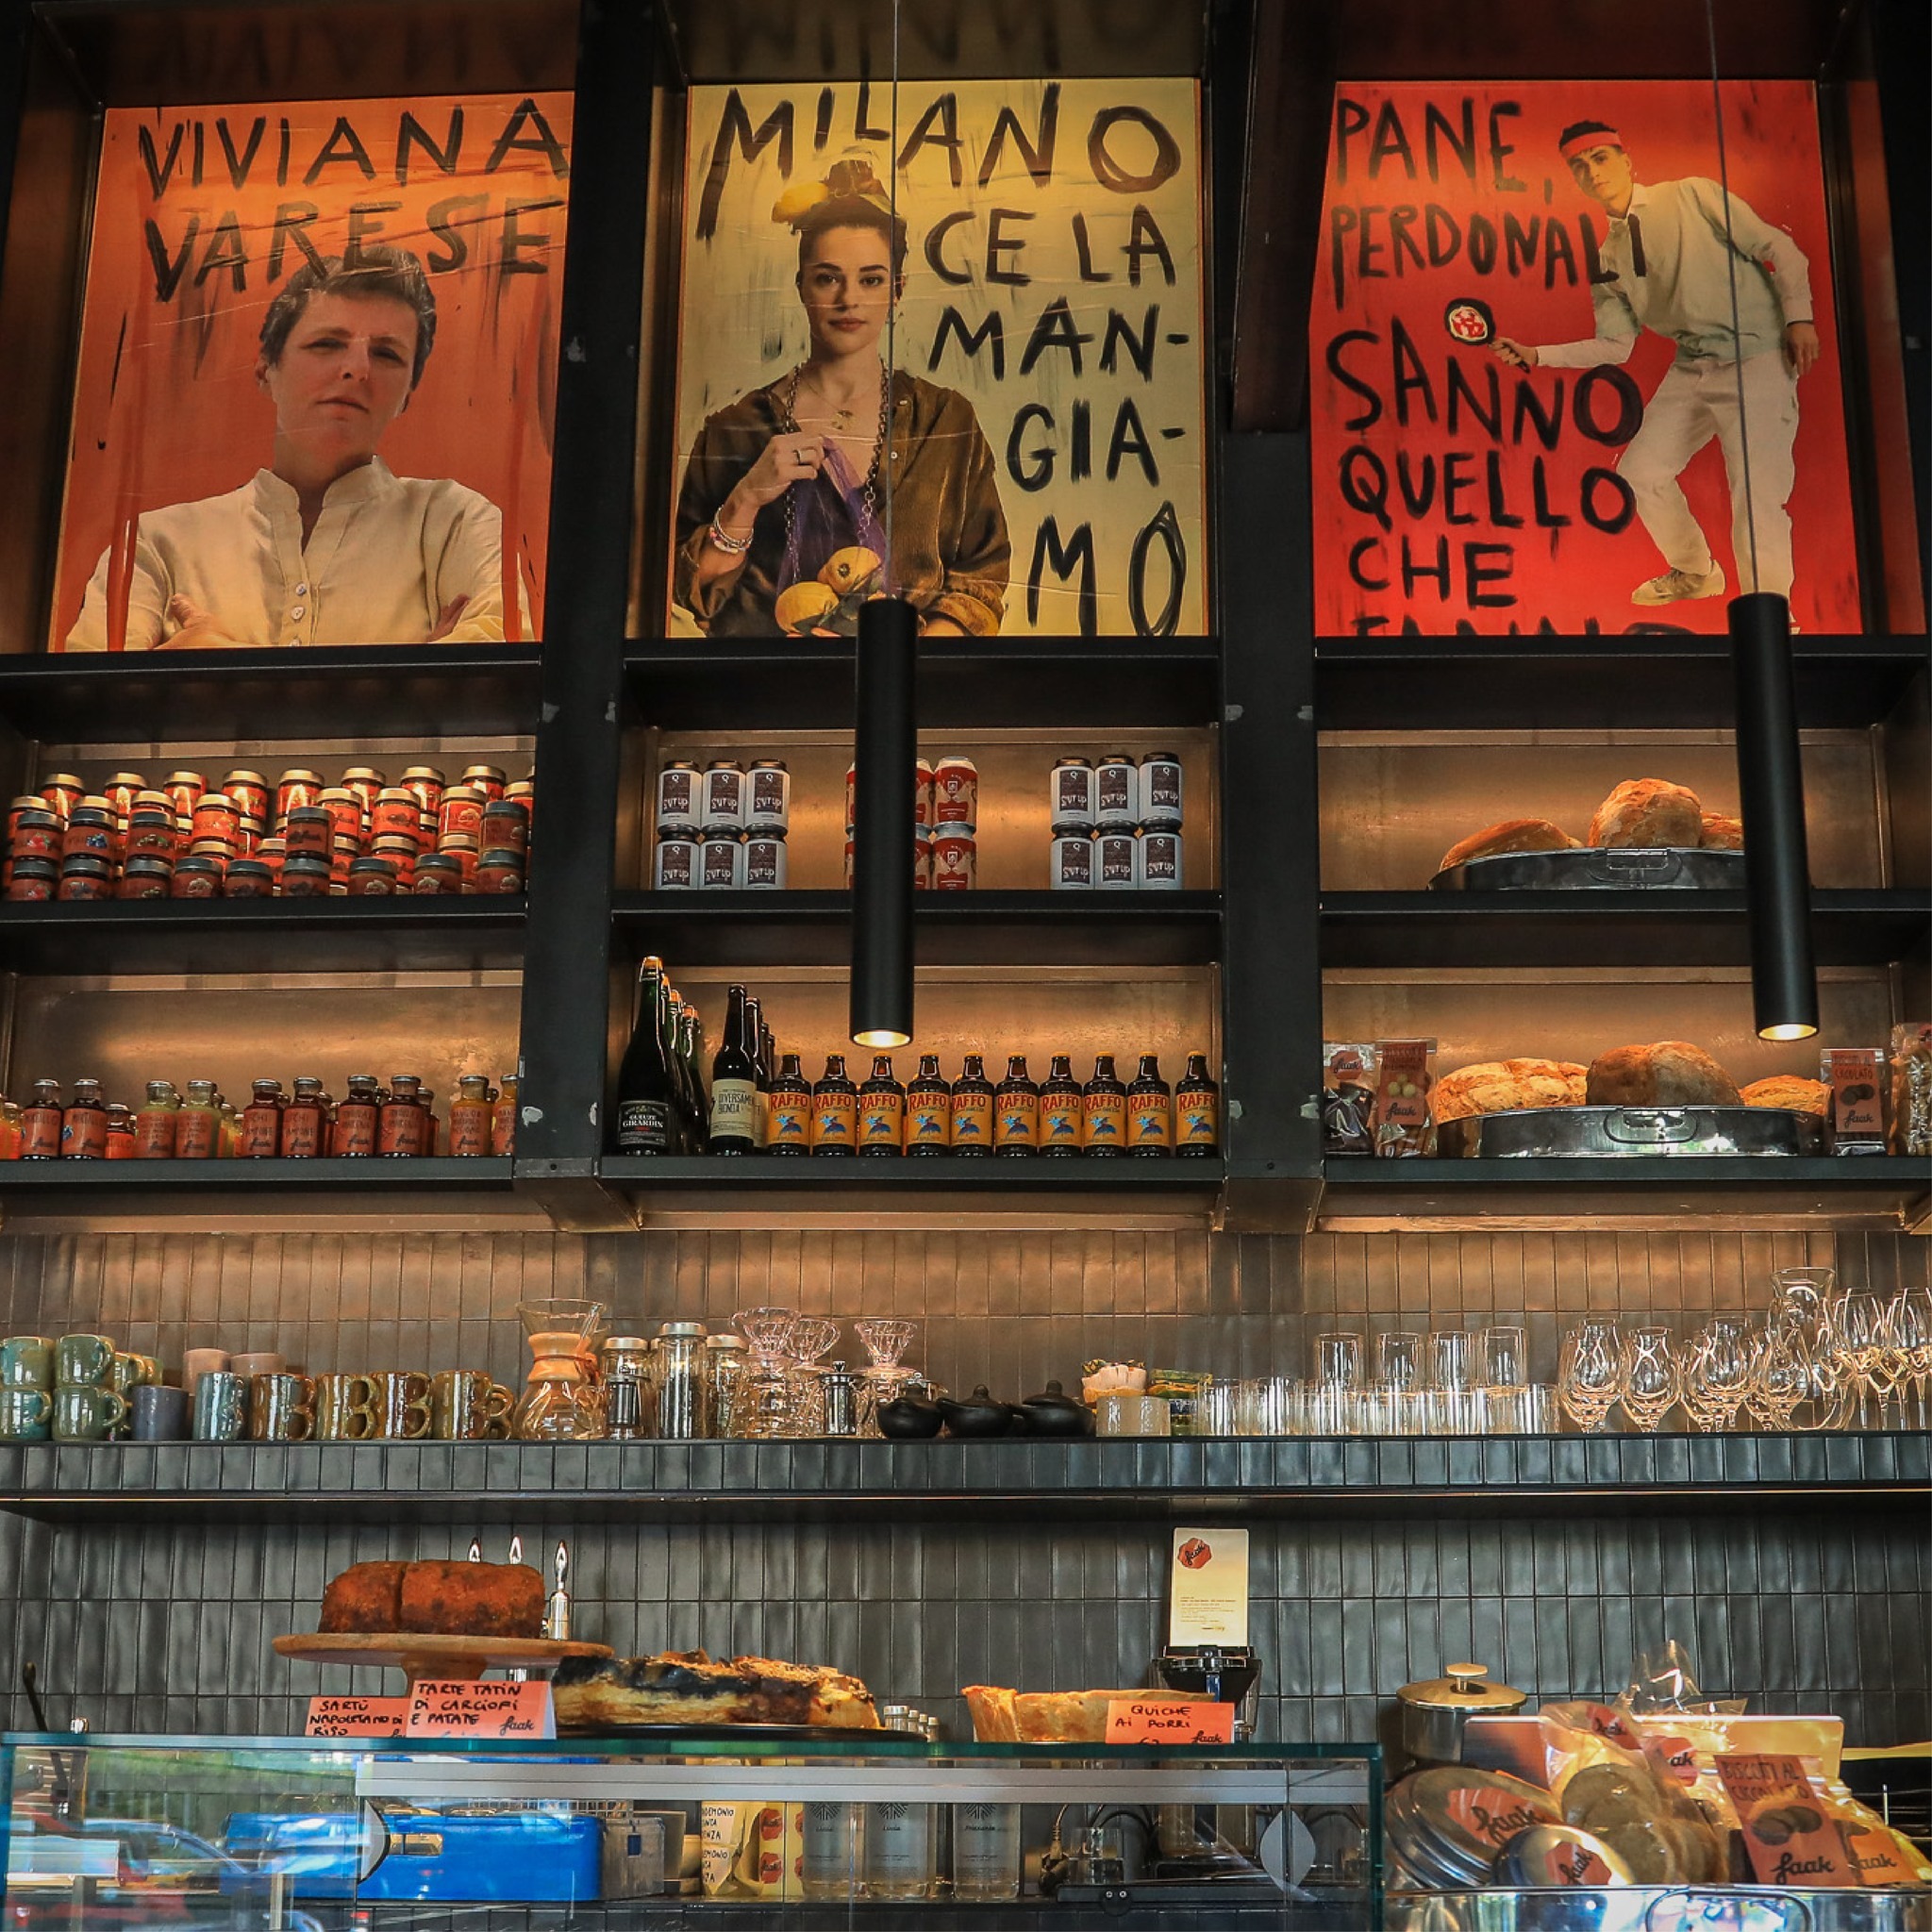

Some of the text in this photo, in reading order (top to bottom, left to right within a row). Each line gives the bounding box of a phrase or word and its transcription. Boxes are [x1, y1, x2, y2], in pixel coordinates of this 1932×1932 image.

[138, 98, 572, 201] VIVIANA
[1336, 98, 1554, 204] PANE,
[696, 82, 1181, 242] MILANO
[144, 193, 566, 302] VARESE
[924, 204, 1177, 287] CE LA
[927, 296, 1191, 383] MAN-
[1326, 314, 1644, 451] SANNO
[1007, 397, 1187, 491] GIA-
[1340, 445, 1637, 534] QUELLO
[1027, 500, 1187, 636] MO
[1348, 534, 1518, 608] CHE
[770, 1094, 808, 1112] RAFFO
[814, 1094, 851, 1111] RAFFO
[860, 1094, 896, 1111] RAFFO
[909, 1094, 947, 1111] RAFFO
[952, 1094, 987, 1111] RAFFO
[998, 1094, 1034, 1111] RAFFO
[1042, 1094, 1079, 1114] RAFFO
[1085, 1094, 1121, 1113] RAFFO
[1132, 1094, 1168, 1113] RAFFO
[1179, 1094, 1215, 1113] RAFFO
[418, 1683, 466, 1695] TARTE
[309, 1714, 389, 1725] NAPOLETANO
[410, 1713, 480, 1725] E PATATE
[499, 1715, 535, 1737] faak
[1770, 1852, 1835, 1885] faak
[1857, 1854, 1897, 1870] aak
